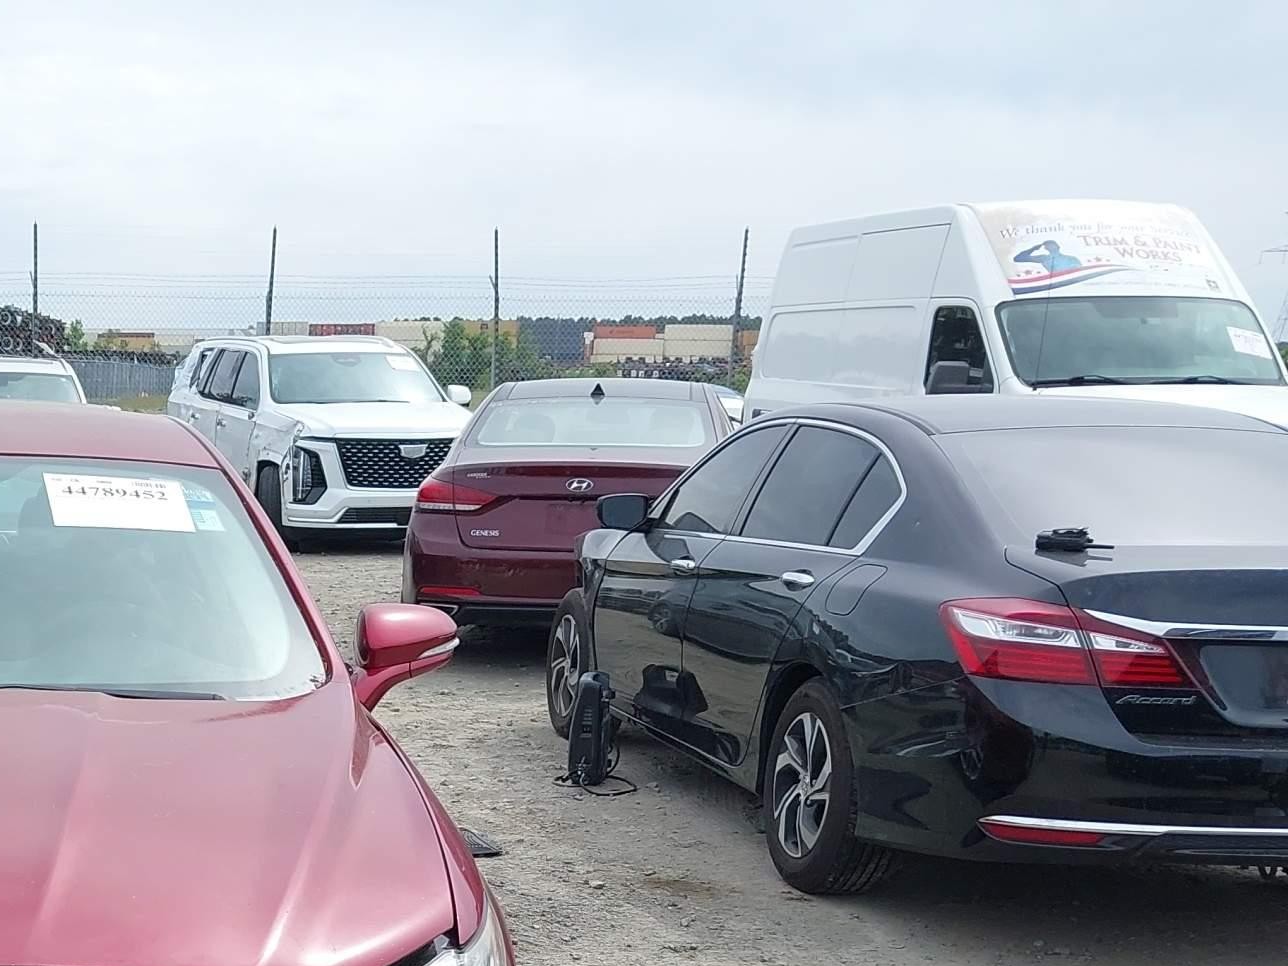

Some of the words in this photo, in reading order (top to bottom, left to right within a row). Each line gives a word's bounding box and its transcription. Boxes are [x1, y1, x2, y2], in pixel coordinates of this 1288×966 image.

[1077, 235, 1128, 247] TRIM
[1133, 235, 1147, 247] &
[1152, 237, 1201, 254] PAINT
[1113, 247, 1183, 263] WORKS
[61, 485, 168, 502] 44789452
[470, 529, 500, 537] GENESIS
[1115, 694, 1197, 705] Accord
